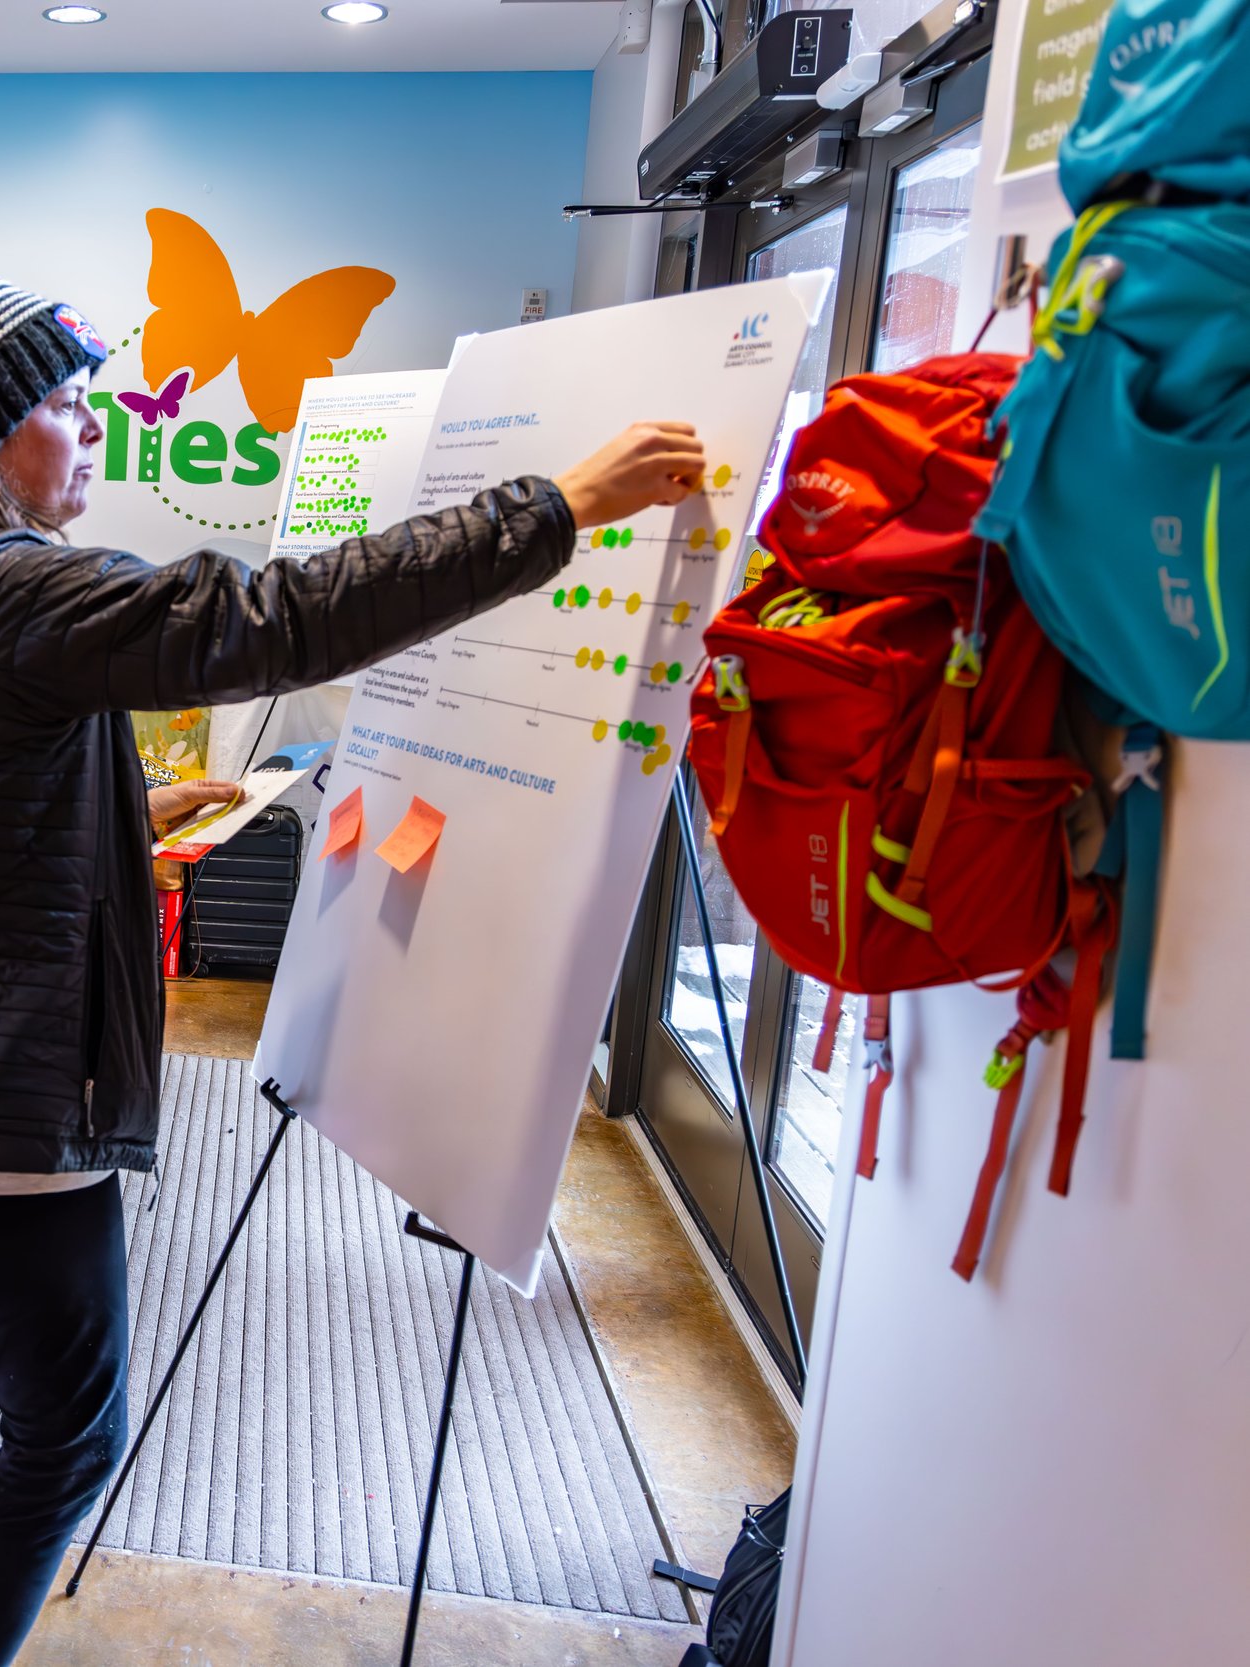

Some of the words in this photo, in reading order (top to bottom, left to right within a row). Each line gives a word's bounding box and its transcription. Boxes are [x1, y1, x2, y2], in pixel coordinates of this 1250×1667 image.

[1033, 66, 1077, 106] field
[525, 306, 543, 314] FIRE
[441, 420, 467, 434] WOULD
[468, 419, 485, 431] YOU
[485, 415, 513, 429] AGREE
[432, 472, 445, 484] quality
[460, 472, 468, 480] and
[469, 472, 485, 480] culture
[787, 471, 856, 499] OSPREY
[421, 487, 443, 496] throughout
[444, 485, 460, 493] Summit
[460, 484, 477, 495] County
[1158, 565, 1201, 640] JET
[406, 672, 419, 682] culture
[365, 677, 374, 685] local
[374, 678, 382, 687] level
[383, 681, 400, 691] increases
[408, 686, 422, 699] quality
[422, 688, 429, 697] of
[374, 692, 395, 706] community
[347, 742, 379, 760] LOCALLY?
[352, 725, 371, 740] WHAT
[371, 731, 385, 744] ARE
[386, 735, 406, 750] YOUR
[406, 740, 420, 754] BIG
[421, 744, 444, 761] IDEAS
[444, 751, 463, 767] FOR
[463, 757, 487, 774] ARTS
[487, 764, 508, 780] AND
[509, 769, 556, 794] CULTURE
[811, 874, 831, 935] JET
